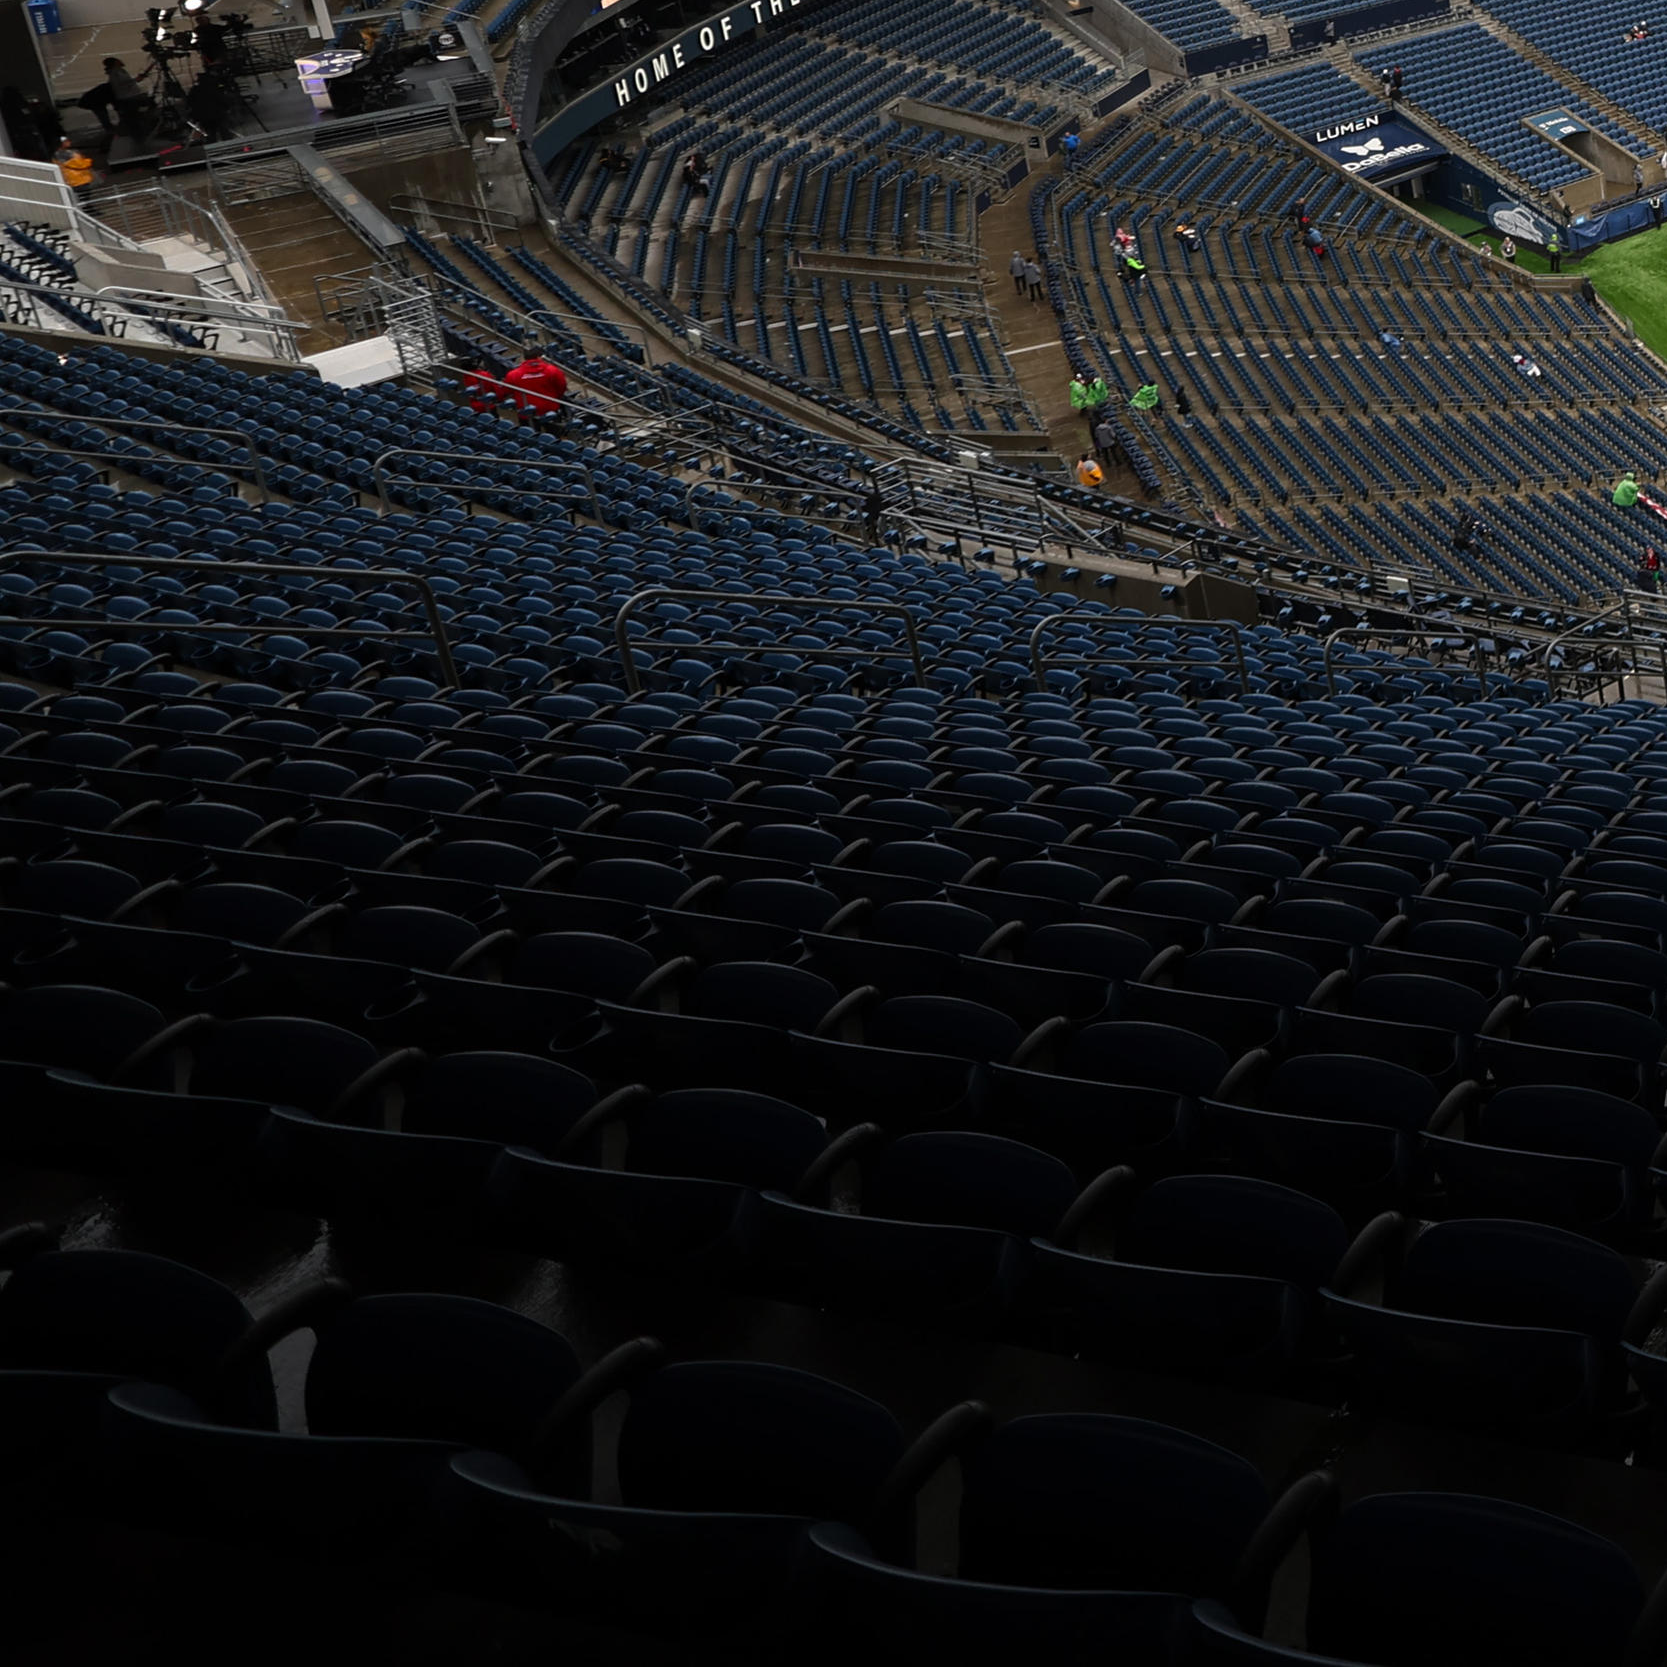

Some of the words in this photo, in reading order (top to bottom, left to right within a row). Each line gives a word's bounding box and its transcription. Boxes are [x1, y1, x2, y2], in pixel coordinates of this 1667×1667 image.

[615, 43, 685, 107] HOME
[700, 16, 732, 52] OF
[1316, 115, 1379, 142] LUMEN
[1341, 144, 1425, 172] DaBella
